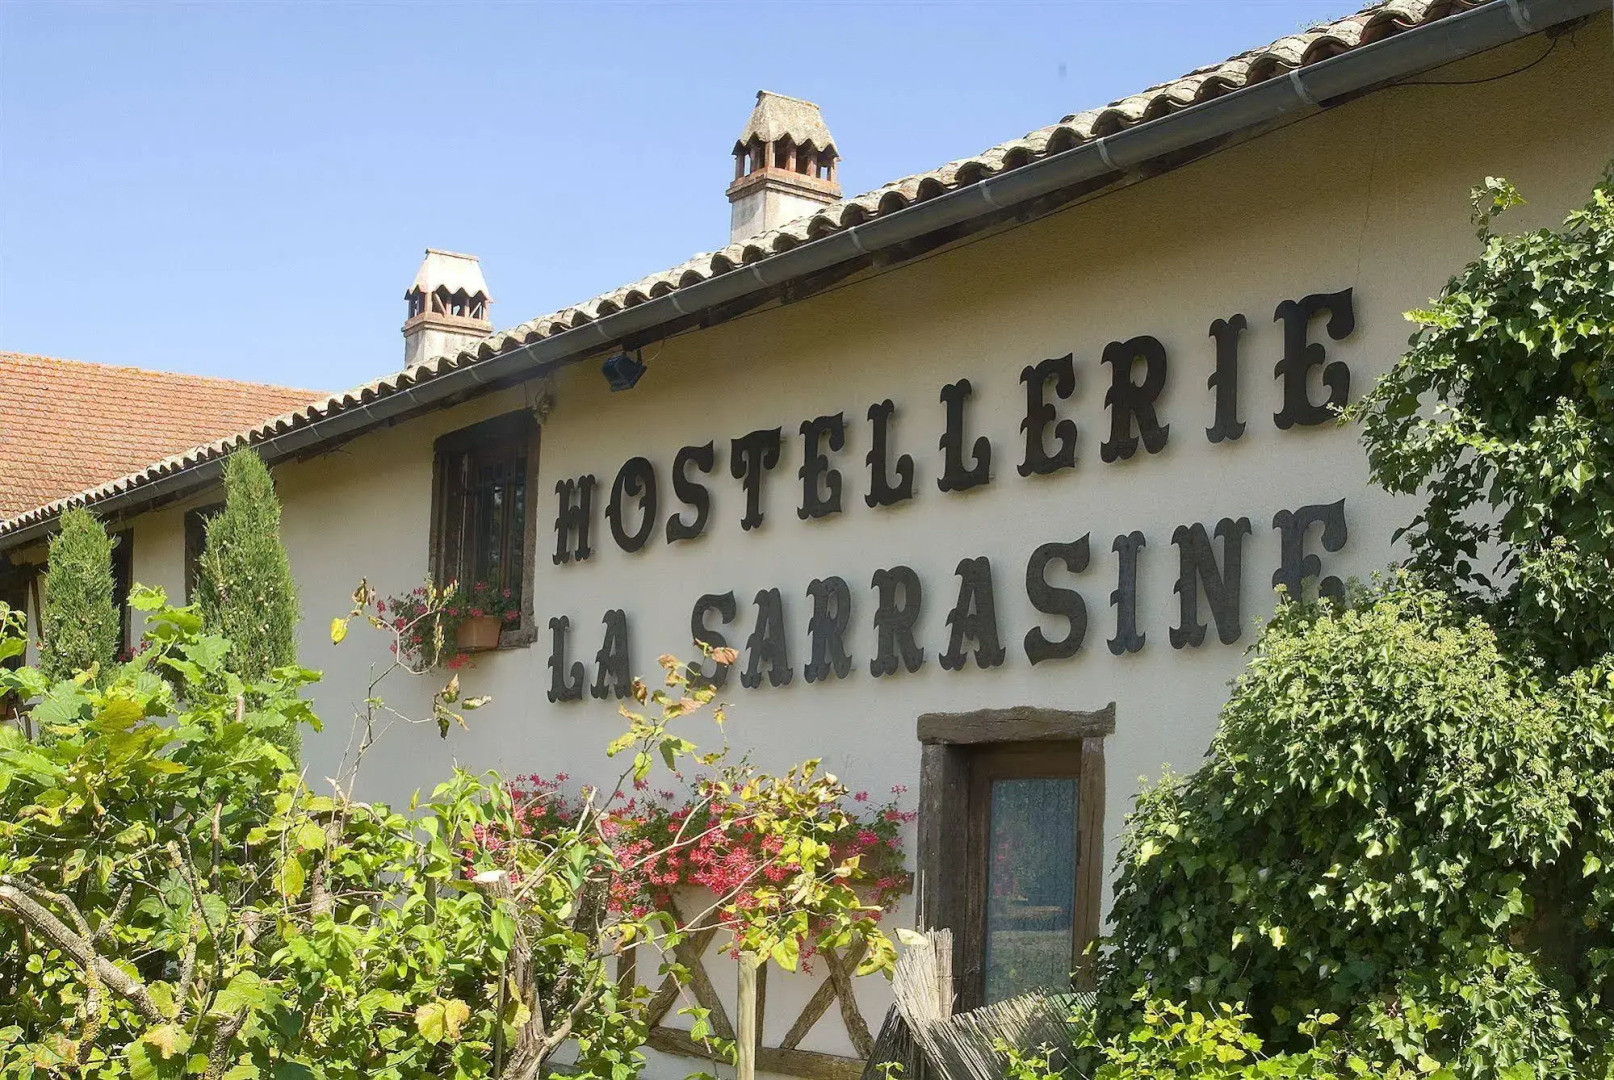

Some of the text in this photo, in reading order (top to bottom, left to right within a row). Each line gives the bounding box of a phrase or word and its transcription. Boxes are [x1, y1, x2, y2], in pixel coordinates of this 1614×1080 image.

[552, 287, 1355, 565] HOSTELLERIE
[547, 498, 1347, 703] LA SARRASINE
